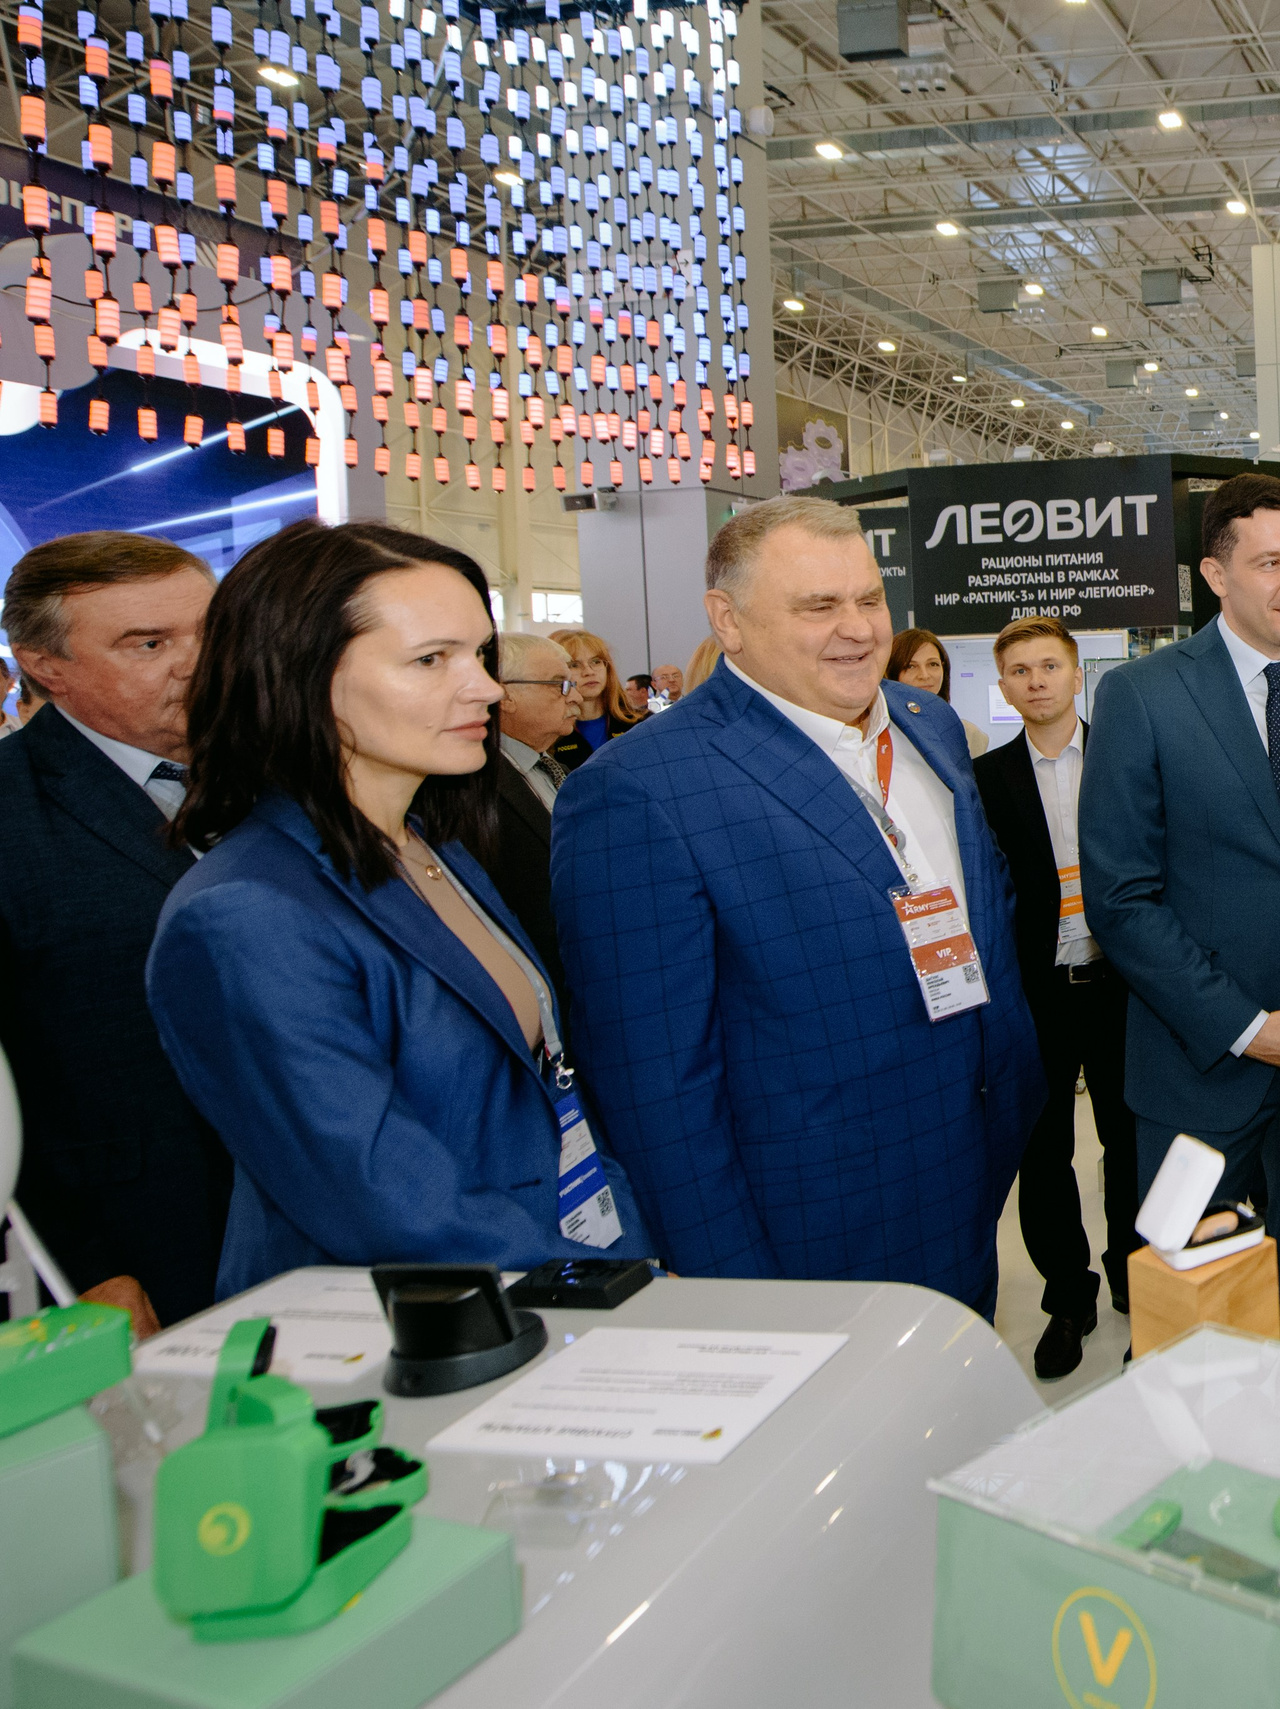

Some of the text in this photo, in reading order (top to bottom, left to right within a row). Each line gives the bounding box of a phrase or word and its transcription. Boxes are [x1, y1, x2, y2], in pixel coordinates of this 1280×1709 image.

[925, 494, 1158, 550] ЛЕОВИТ
[981, 552, 1104, 571] РАЦИОНЫ ПИТАНИЯ
[879, 566, 906, 577] УКТЫ
[968, 568, 1119, 588] РАЗРАБОТАНЫ В РАМКАХ
[934, 584, 1155, 606] НИР «РАТНИК-3» И НИР «ЛЕГИОНЕР»
[1010, 604, 1082, 621] ДЛЯ МО РФ
[936, 946, 952, 959] VIP
